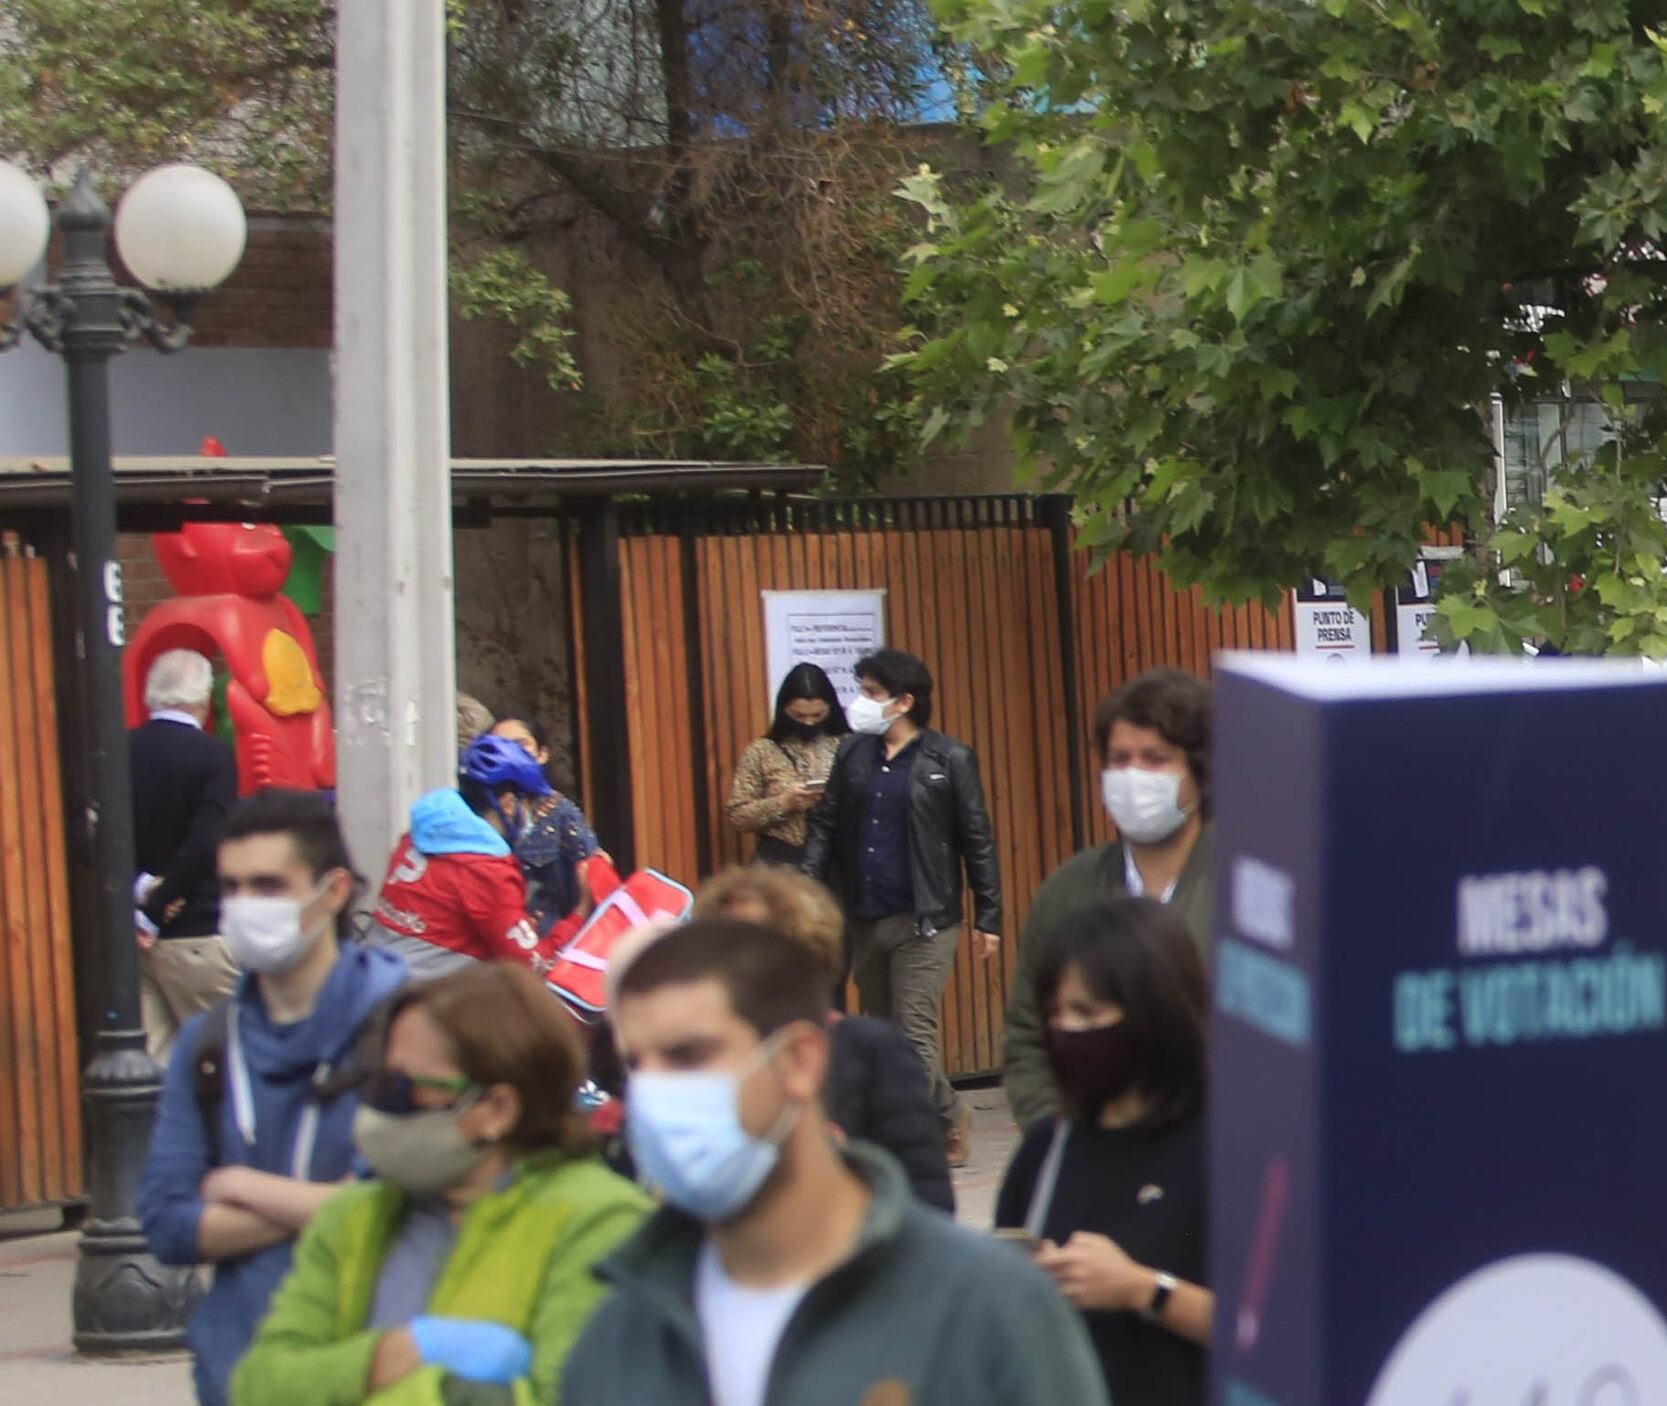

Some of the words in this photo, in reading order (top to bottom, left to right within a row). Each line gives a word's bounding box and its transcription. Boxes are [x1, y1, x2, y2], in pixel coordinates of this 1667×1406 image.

[1313, 611, 1342, 625] PUNTO
[1343, 611, 1355, 625] DE
[1317, 627, 1352, 641] PRENSA
[1457, 866, 1609, 957] MESAS
[1393, 968, 1457, 1050] DE
[1462, 938, 1667, 1046] VOTACIÓN
